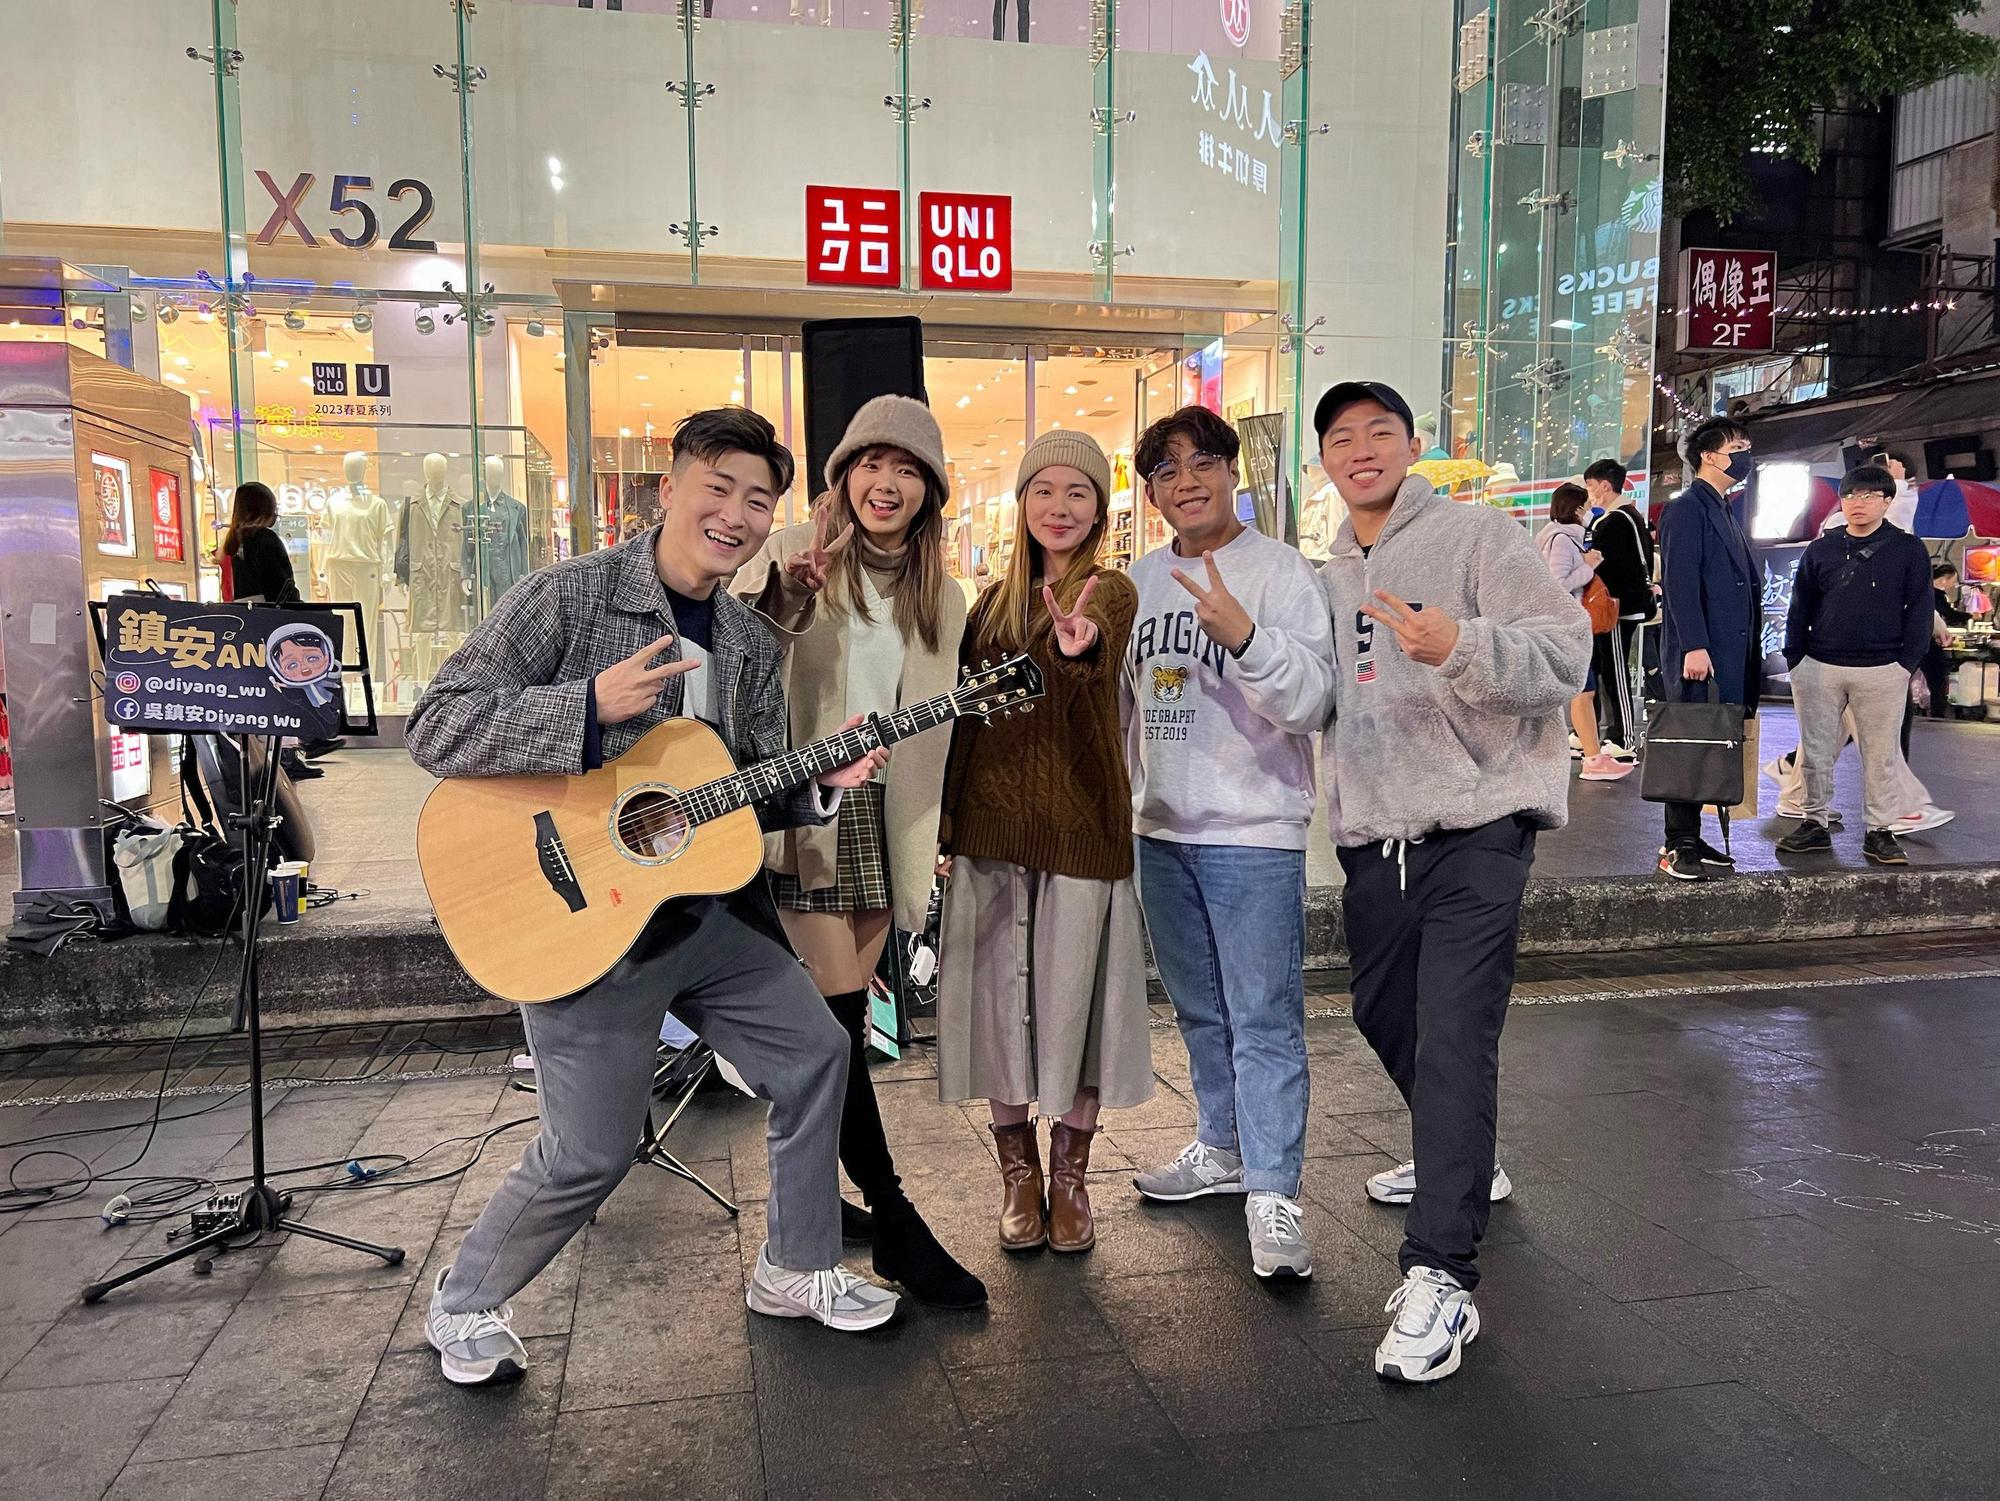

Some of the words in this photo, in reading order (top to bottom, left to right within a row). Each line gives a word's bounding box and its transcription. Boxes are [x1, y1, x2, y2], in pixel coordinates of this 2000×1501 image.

[254, 170, 438, 253] X52
[930, 204, 994, 240] UNI
[931, 243, 1001, 283] QLO
[1692, 257, 1770, 311] 偶像王
[1712, 323, 1751, 347] 2F
[315, 366, 342, 379] UNI
[363, 368, 383, 393] U
[317, 380, 345, 394] QLO
[314, 403, 392, 416] 2023春夏系列
[1131, 611, 1227, 679] RIGIN
[145, 675, 266, 699] @diyang_wu
[273, 714, 301, 728] Wu
